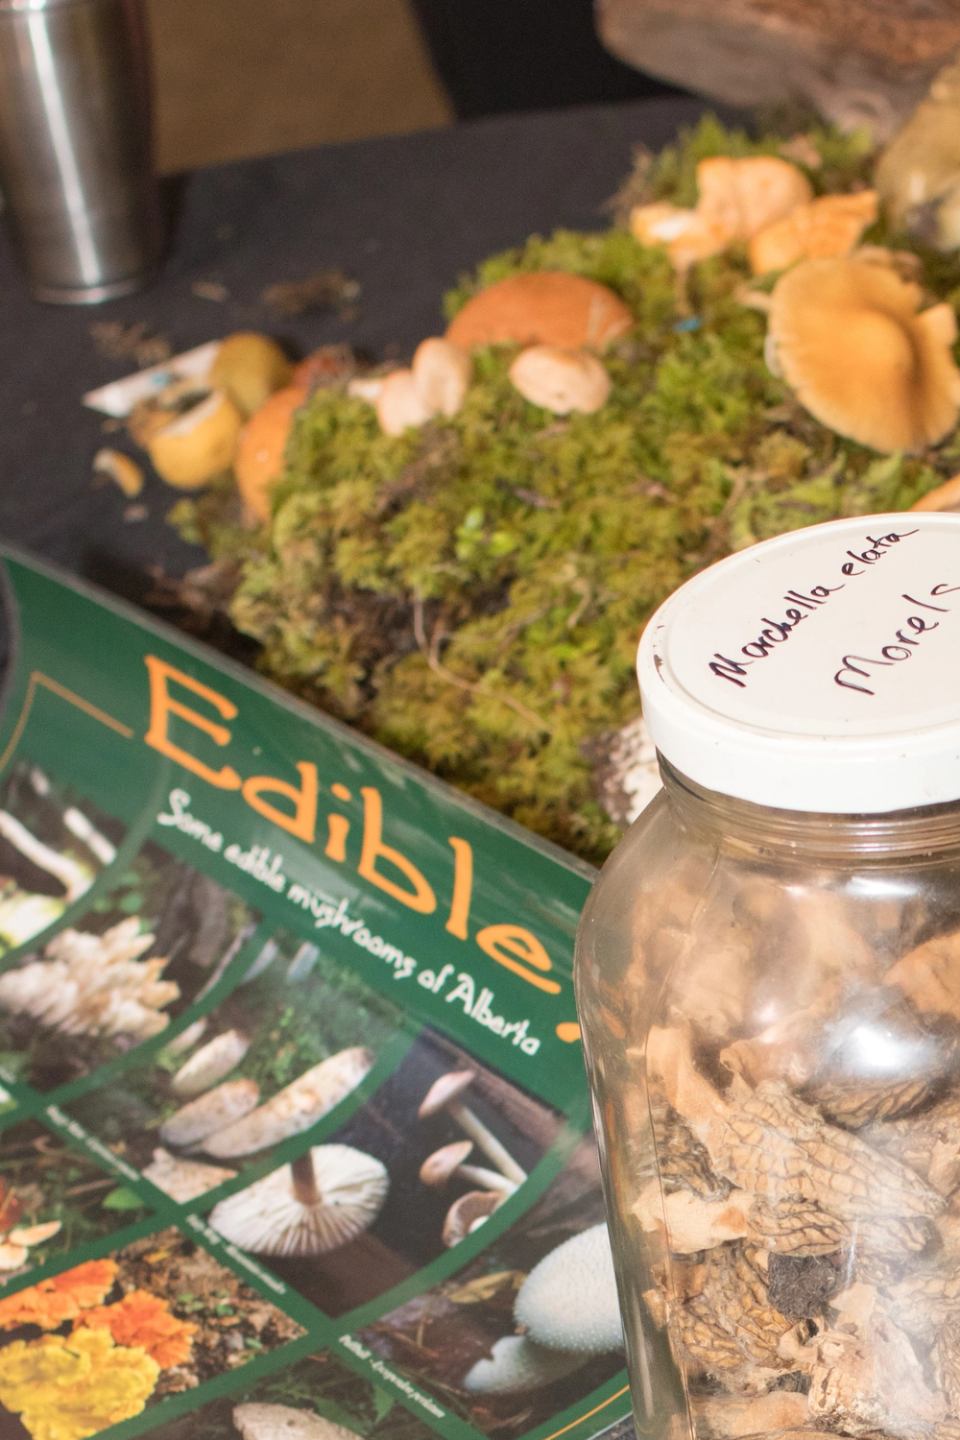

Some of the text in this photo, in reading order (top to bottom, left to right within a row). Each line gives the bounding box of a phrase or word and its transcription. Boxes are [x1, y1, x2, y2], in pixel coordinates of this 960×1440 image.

[841, 528, 920, 577] elata
[144, 655, 561, 994] Edible
[157, 788, 541, 1056] Some edible mushrooms of Alberta
